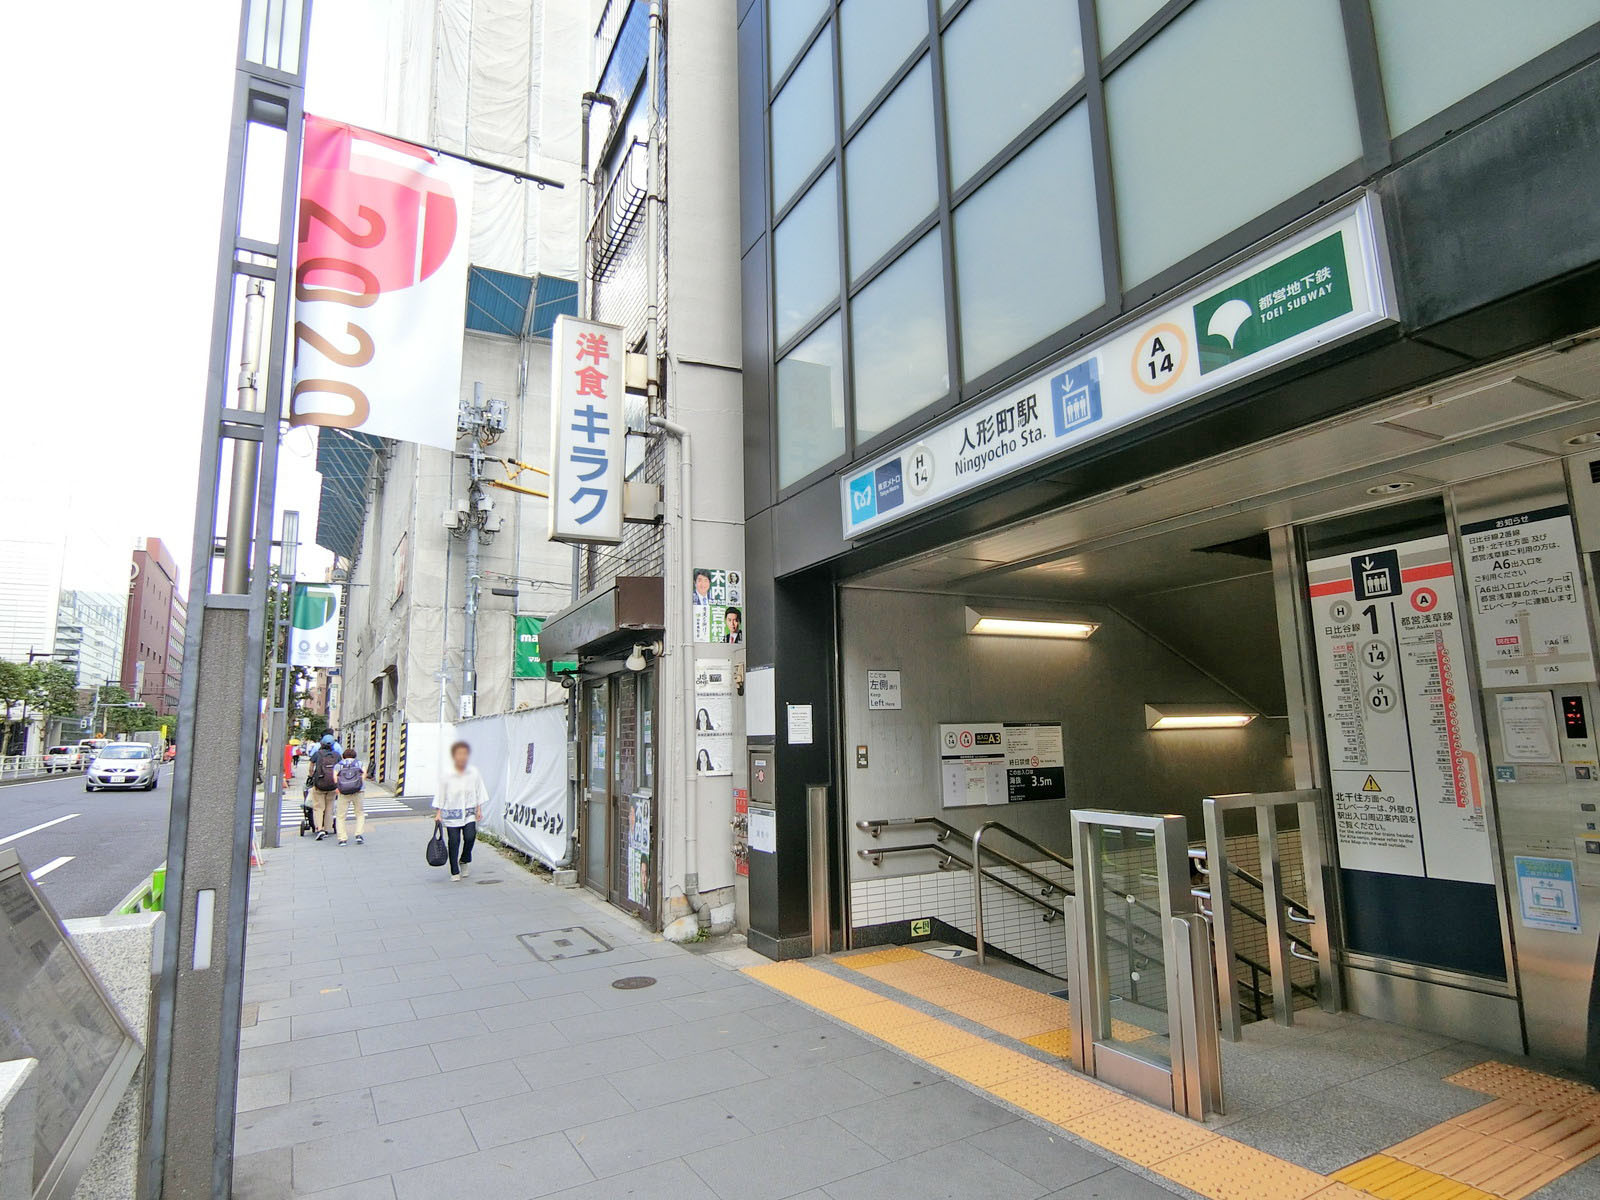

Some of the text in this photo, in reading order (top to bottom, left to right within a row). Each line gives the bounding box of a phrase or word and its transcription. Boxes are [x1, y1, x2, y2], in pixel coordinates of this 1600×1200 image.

[1259, 266, 1332, 311] 都営地下鉄
[1261, 283, 1333, 323] TOEI SUBWAY
[290, 198, 386, 428] 2020
[1151, 337, 1165, 357] A
[1148, 353, 1174, 380] 14
[569, 332, 610, 525] 洋食 キラク
[959, 394, 1038, 456] 人形町駅
[955, 428, 1047, 476] Ningyocho Sta.
[916, 454, 924, 469] H
[915, 468, 928, 486] 14
[1495, 516, 1529, 528] お知らせ
[1469, 529, 1520, 544] 日比谷線2番線
[1492, 557, 1543, 571] A6出入口を
[1475, 569, 1527, 582] ご利用ください
[711, 570, 726, 600] 木内
[1480, 575, 1570, 594] A6出入口エレベーターは
[1420, 596, 1429, 604] A
[1481, 585, 1571, 602] 都営浅草線のホーム行き
[1482, 594, 1573, 611] エレベーターに連絡します
[1337, 608, 1345, 616] H
[1362, 604, 1379, 634] 1
[1401, 612, 1453, 626] 都営浅草線
[711, 606, 726, 637] 吉村
[1325, 623, 1360, 635] 日比谷線
[1368, 651, 1385, 663] 14
[870, 699, 884, 707] Left
[1372, 695, 1389, 707] 01
[988, 733, 1001, 744] A3
[1031, 775, 1053, 787] 3.5m
[1336, 792, 1395, 803] 北千住方面への
[1337, 803, 1413, 814] エレベーターは、外壁の
[1337, 811, 1416, 823] 駅出入口周辺案内図を
[1339, 821, 1386, 831] ご覧ください。
